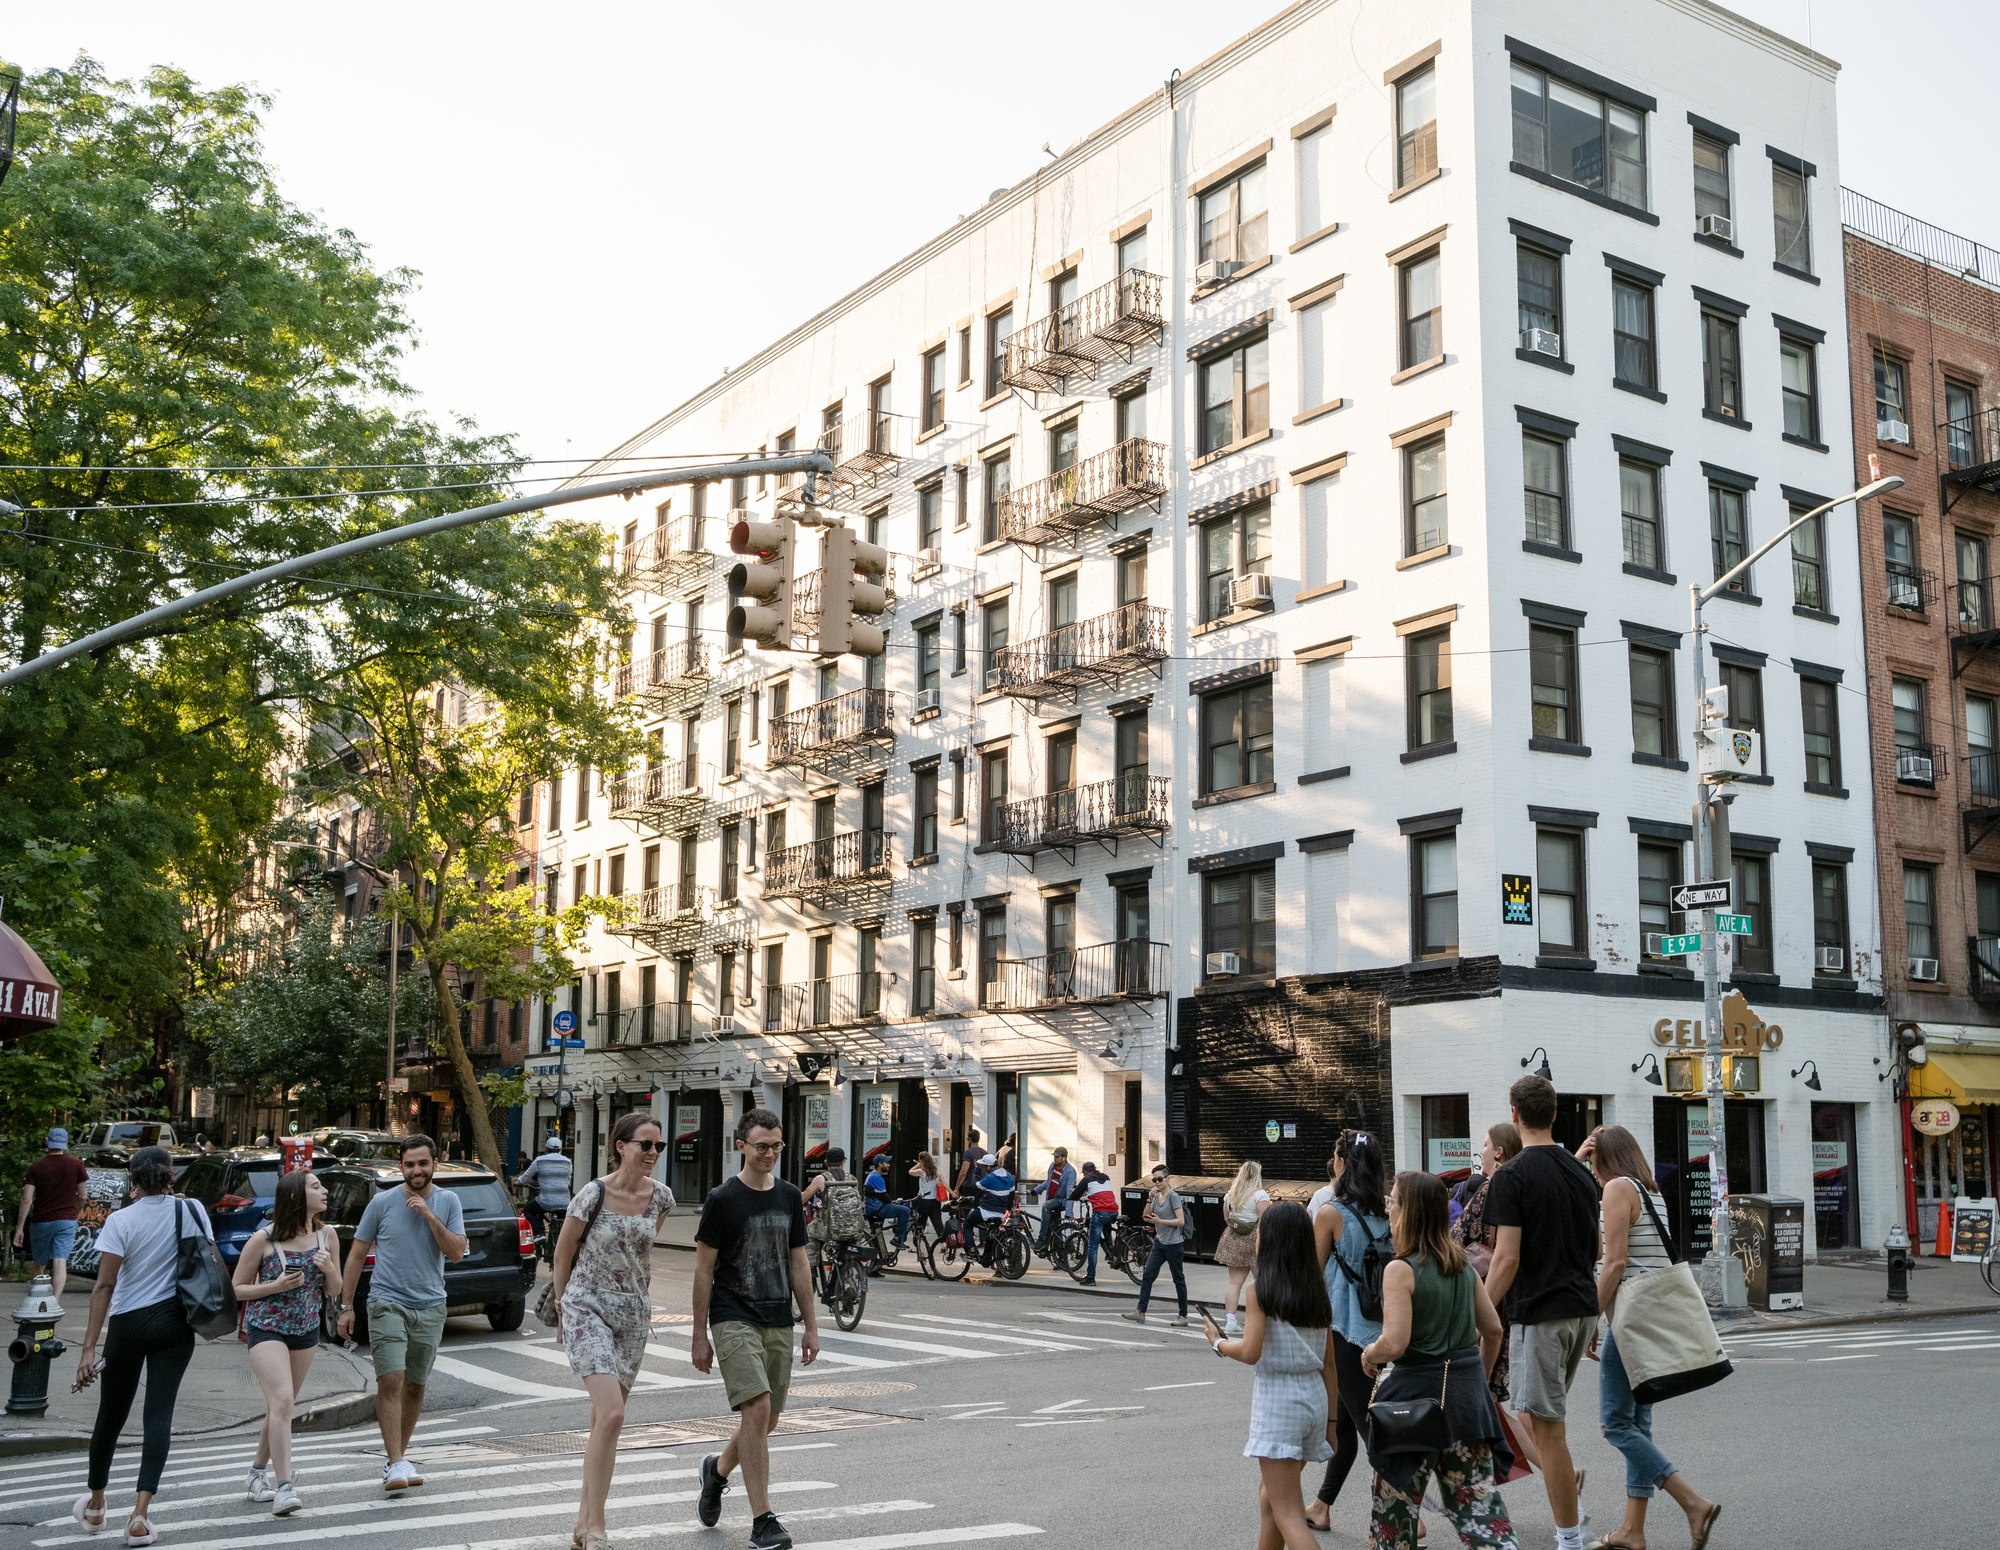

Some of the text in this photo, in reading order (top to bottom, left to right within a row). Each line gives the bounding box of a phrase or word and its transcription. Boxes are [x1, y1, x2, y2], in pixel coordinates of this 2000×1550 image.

[1680, 890, 1723, 904] ONE WAY
[1719, 916, 1748, 932] AVE A
[1668, 936, 1696, 953] E 9 ST
[0, 981, 14, 1013] 1
[811, 1099, 828, 1110] RETAIL
[871, 1098, 889, 1109] RETAIL
[811, 1111, 828, 1121] SPACE
[871, 1110, 889, 1121] SPACE
[1444, 1141, 1471, 1150] RETAIL SPACE
[1690, 1171, 1710, 1179] GROU
[1690, 1190, 1711, 1198] 600 SQ
[1691, 1208, 1702, 1216] 724
